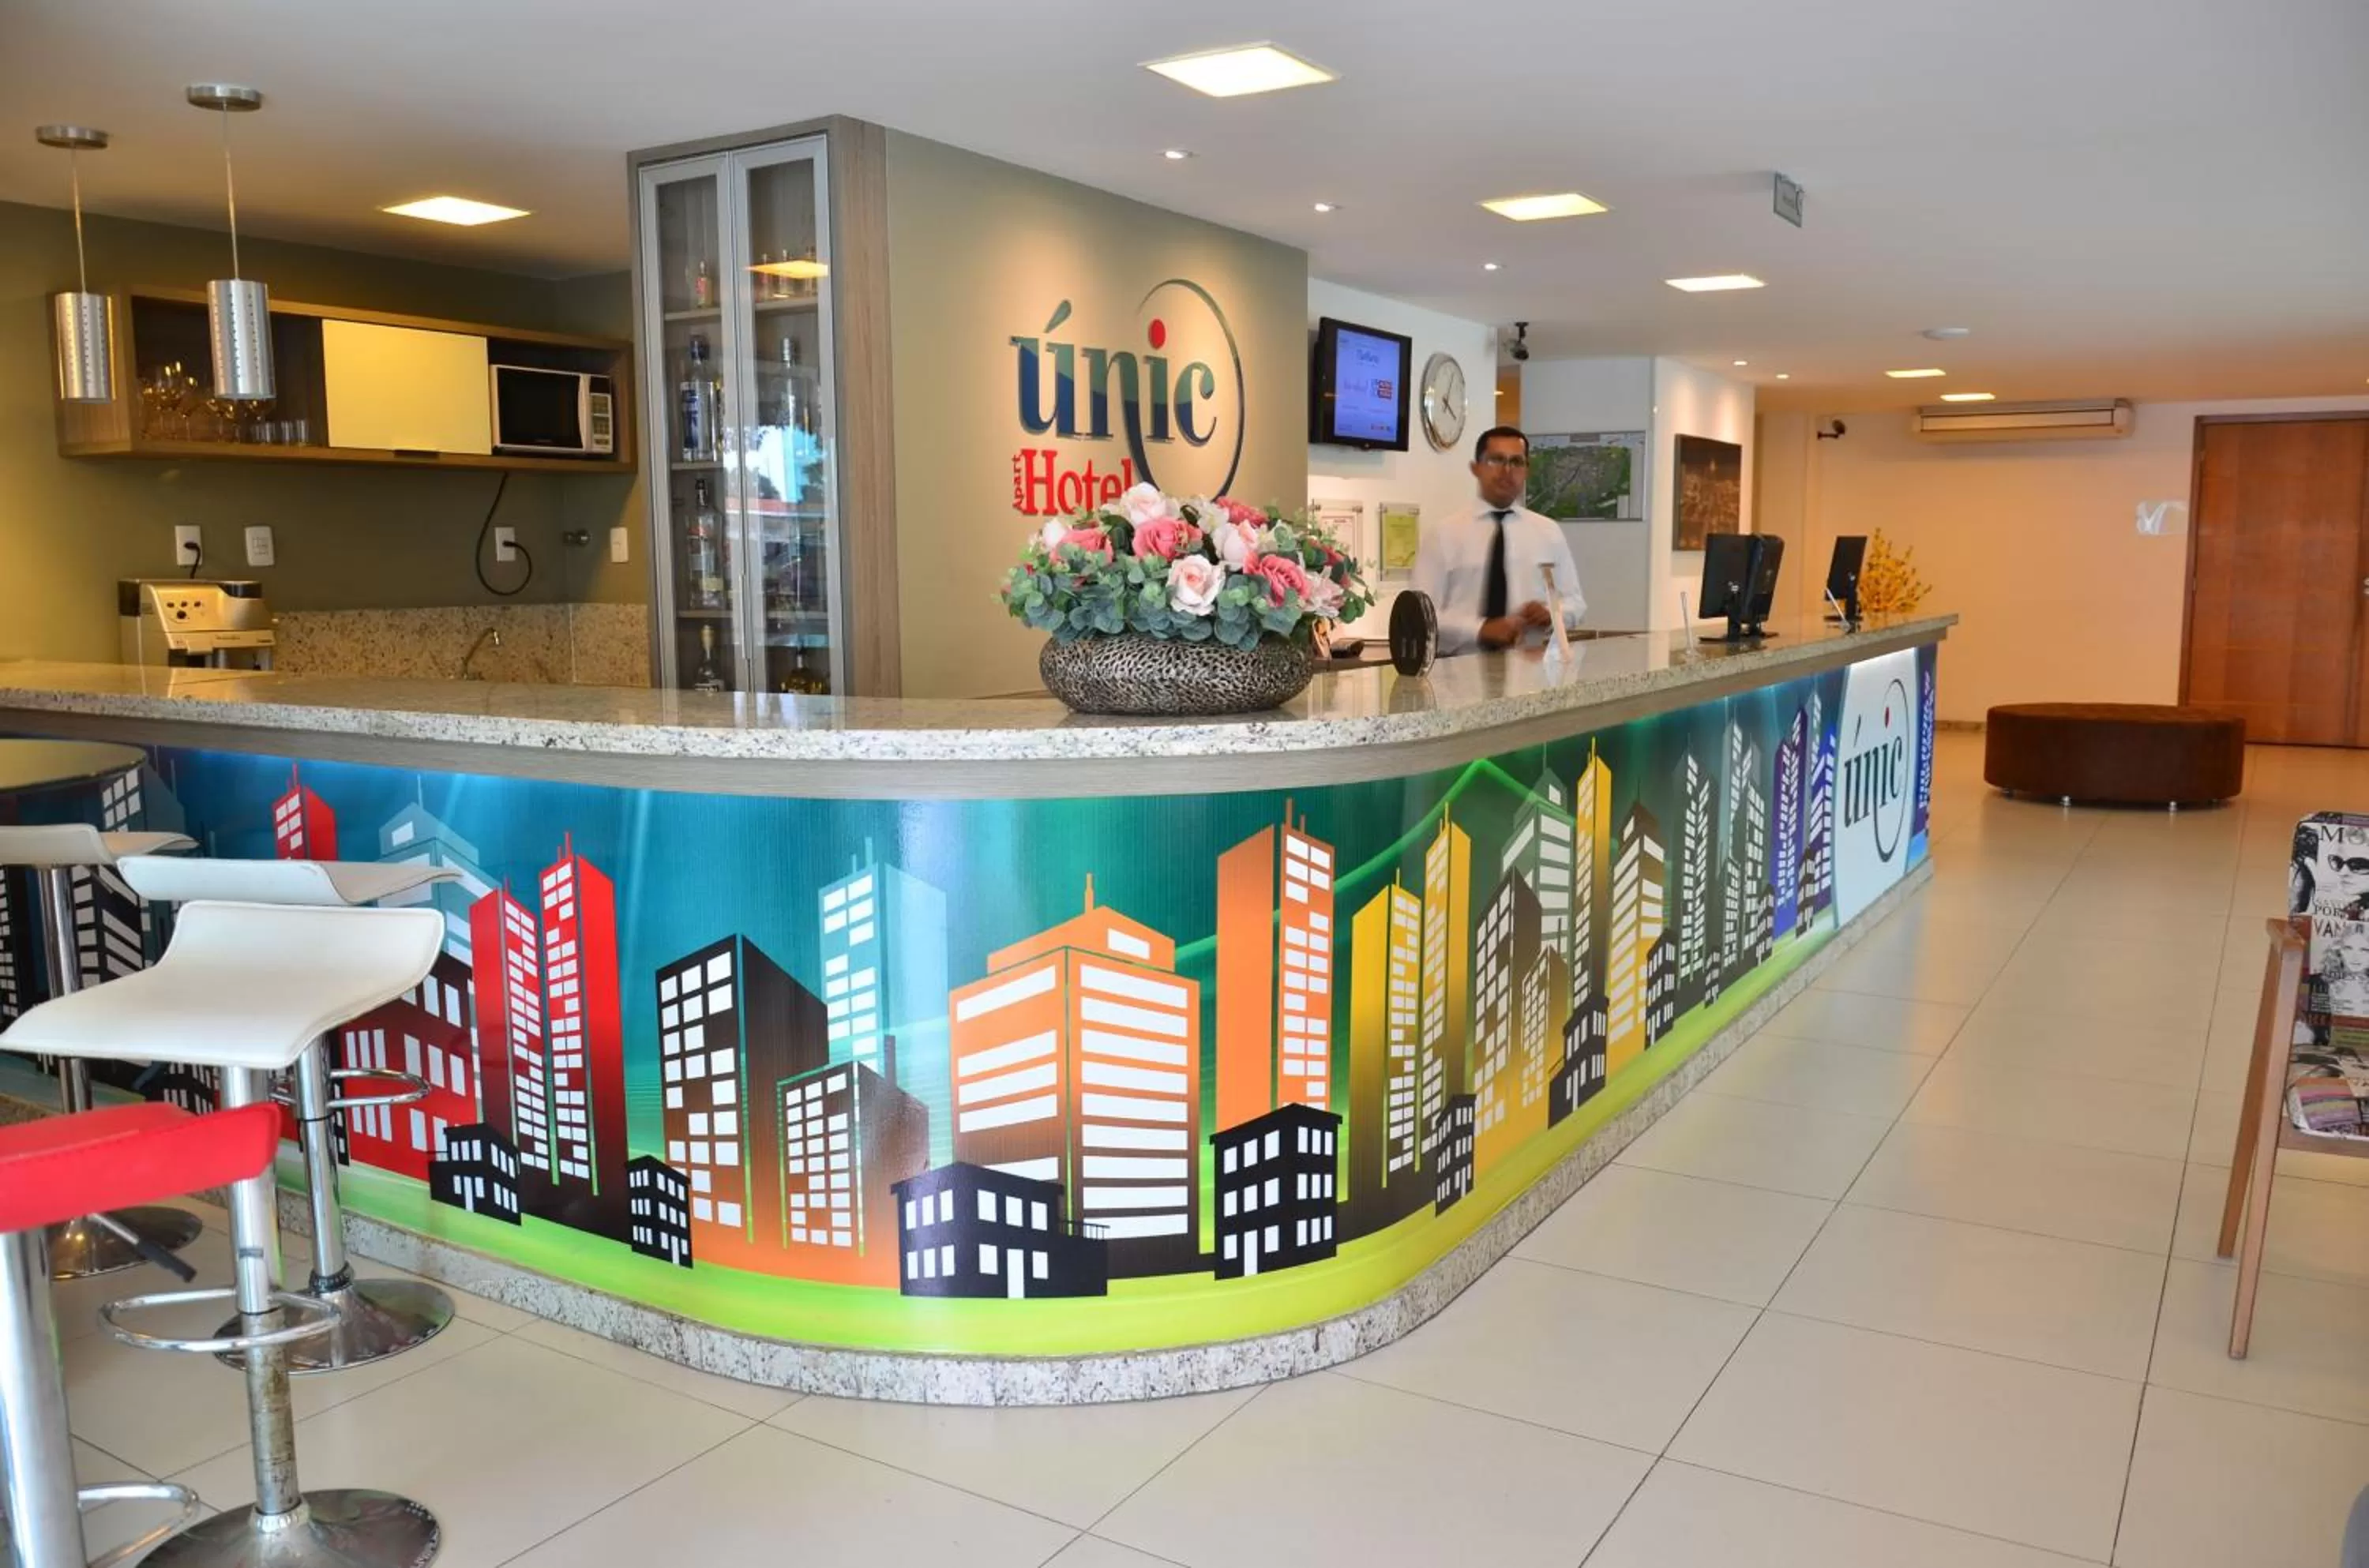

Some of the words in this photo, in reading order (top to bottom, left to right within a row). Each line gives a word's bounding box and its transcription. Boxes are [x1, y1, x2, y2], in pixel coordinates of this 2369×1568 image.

[1009, 294, 1224, 466] únic
[1012, 454, 1024, 511] Apart
[1843, 700, 1905, 842] únic
